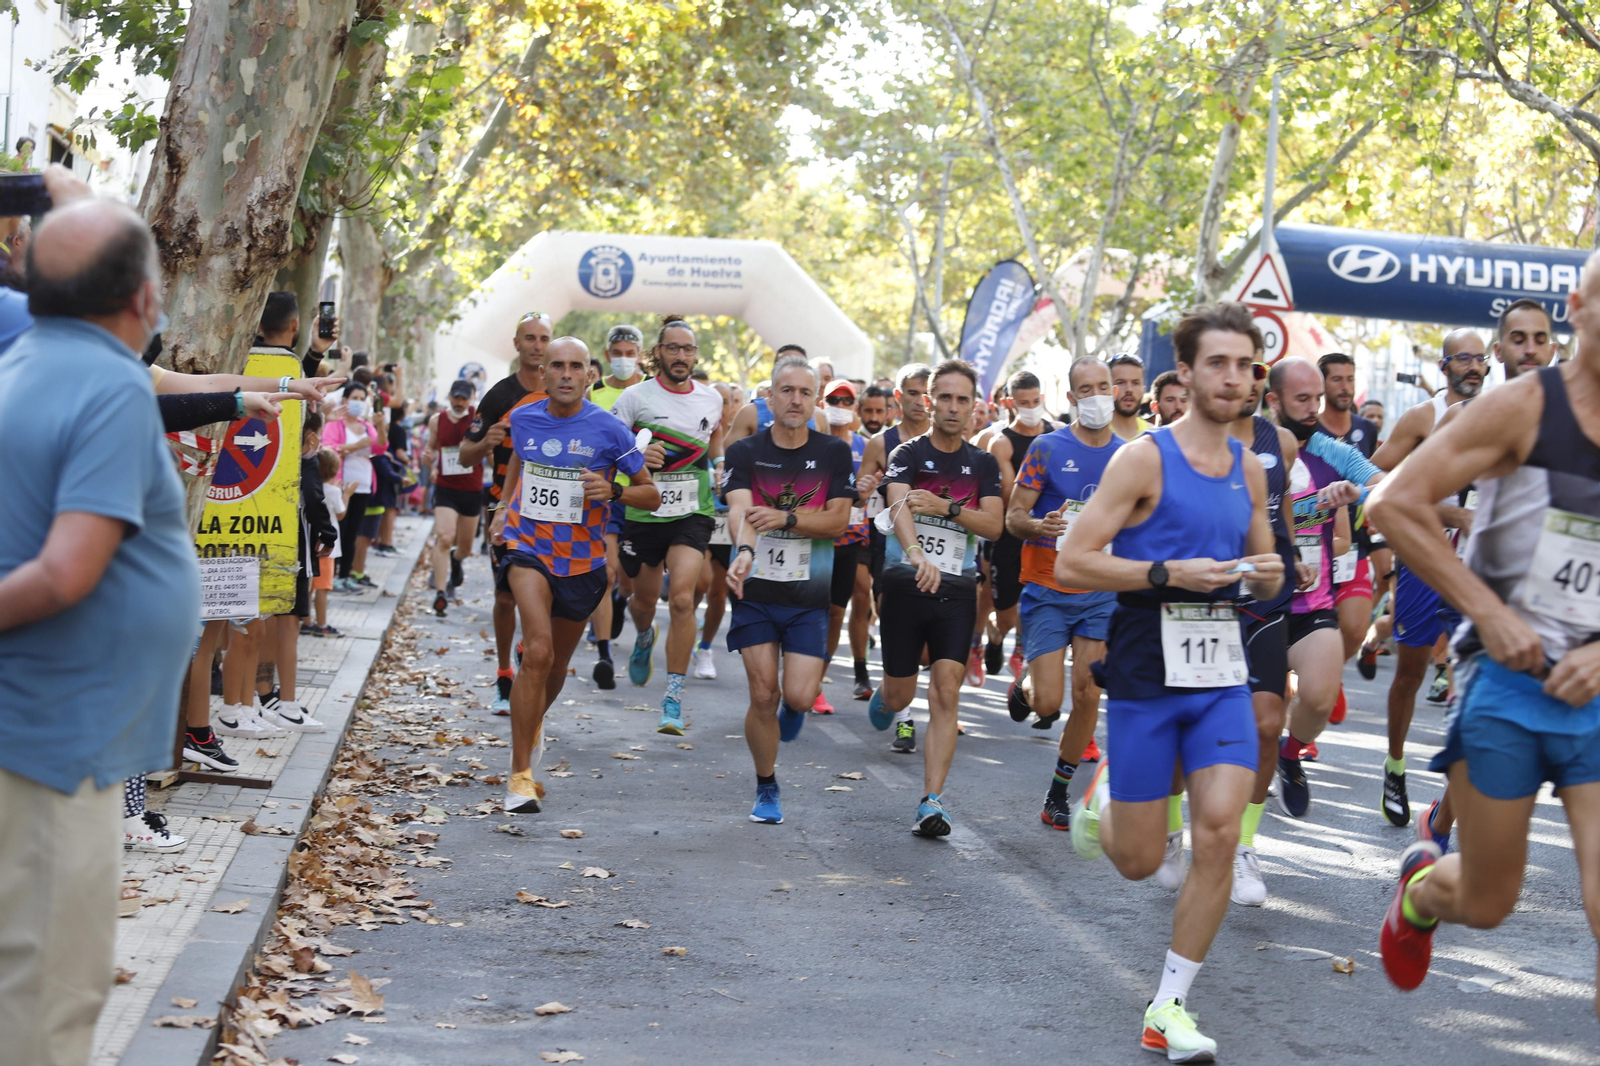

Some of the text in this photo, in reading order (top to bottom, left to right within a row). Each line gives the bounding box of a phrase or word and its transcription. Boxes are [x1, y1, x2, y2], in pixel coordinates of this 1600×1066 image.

[638, 252, 742, 266] Ayuntamiento
[667, 266, 742, 279] de Huelva
[974, 277, 1016, 376] HYUNDAI
[1264, 331, 1277, 349] 0
[207, 485, 243, 499] GRUA
[529, 485, 560, 507] 356
[661, 490, 683, 504] 634
[197, 515, 283, 534] LA ZONA
[916, 534, 946, 556] 655
[767, 548, 785, 567] 14
[1180, 638, 1219, 664] 117
